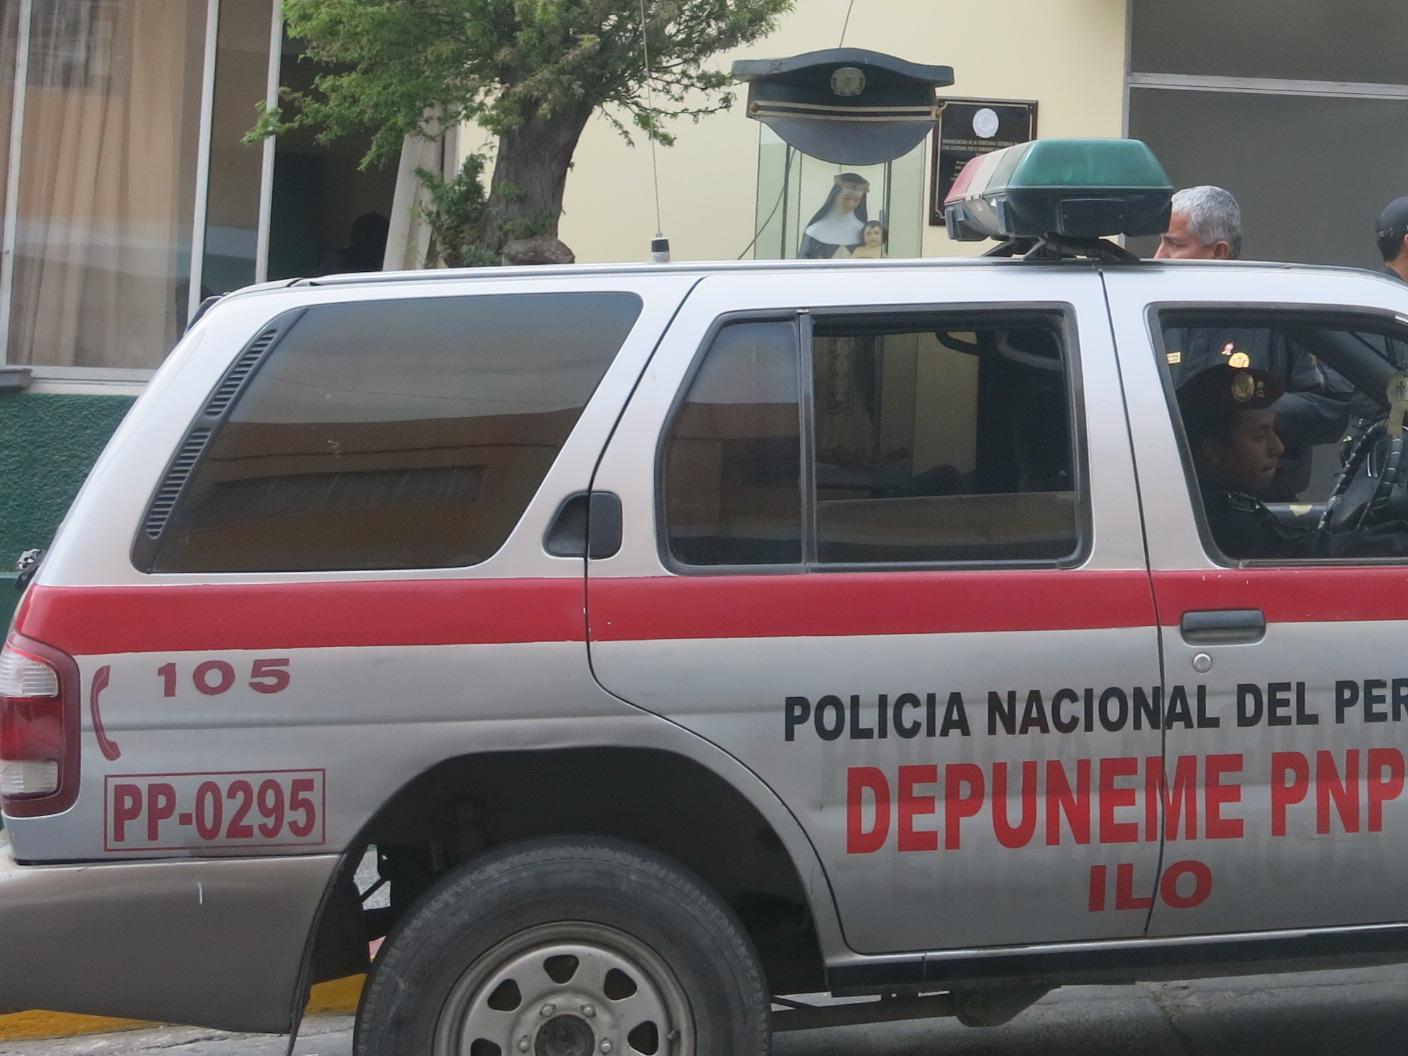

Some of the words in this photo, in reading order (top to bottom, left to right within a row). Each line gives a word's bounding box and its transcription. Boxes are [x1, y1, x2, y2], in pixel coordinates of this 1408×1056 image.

[157, 657, 291, 697] 105
[784, 691, 971, 742] POLICIA
[986, 683, 1221, 736] NACIONAL
[1236, 681, 1320, 727] DEL
[113, 778, 316, 842] PP-0295
[846, 753, 1245, 854] DEPUNEME
[1270, 747, 1406, 837] PNP
[1088, 859, 1213, 912] ILO
